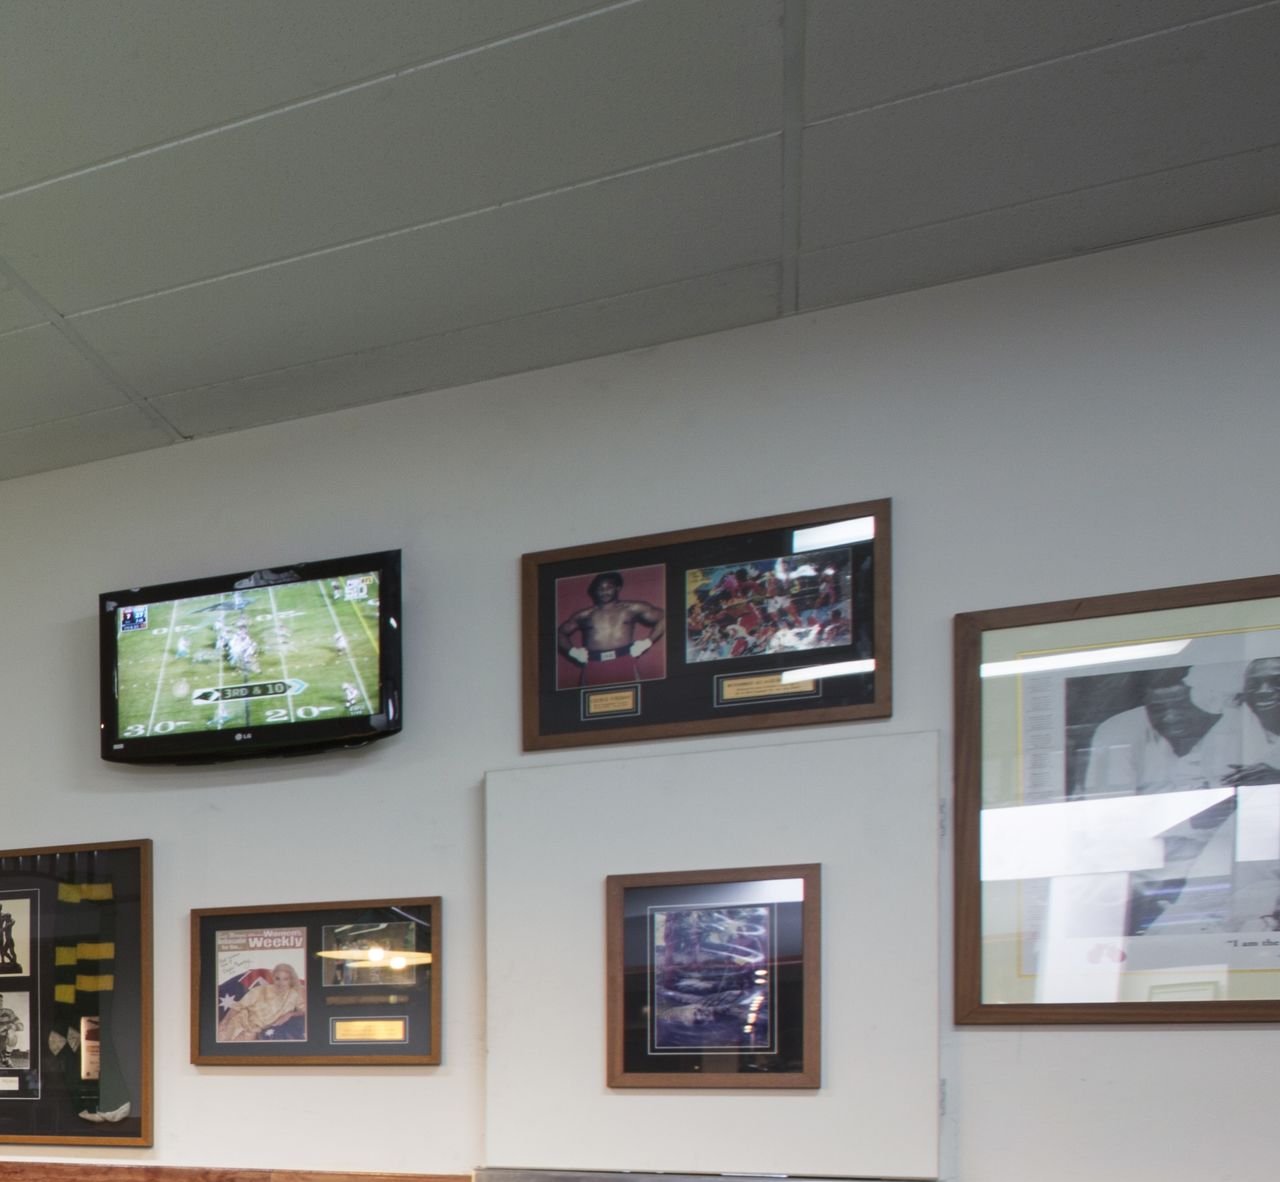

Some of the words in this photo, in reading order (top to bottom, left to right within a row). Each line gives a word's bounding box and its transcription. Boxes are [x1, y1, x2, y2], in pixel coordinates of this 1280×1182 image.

[223, 687, 248, 699] 3RD
[252, 686, 261, 696] &
[267, 684, 285, 695] 10
[248, 935, 304, 948] Weekly
